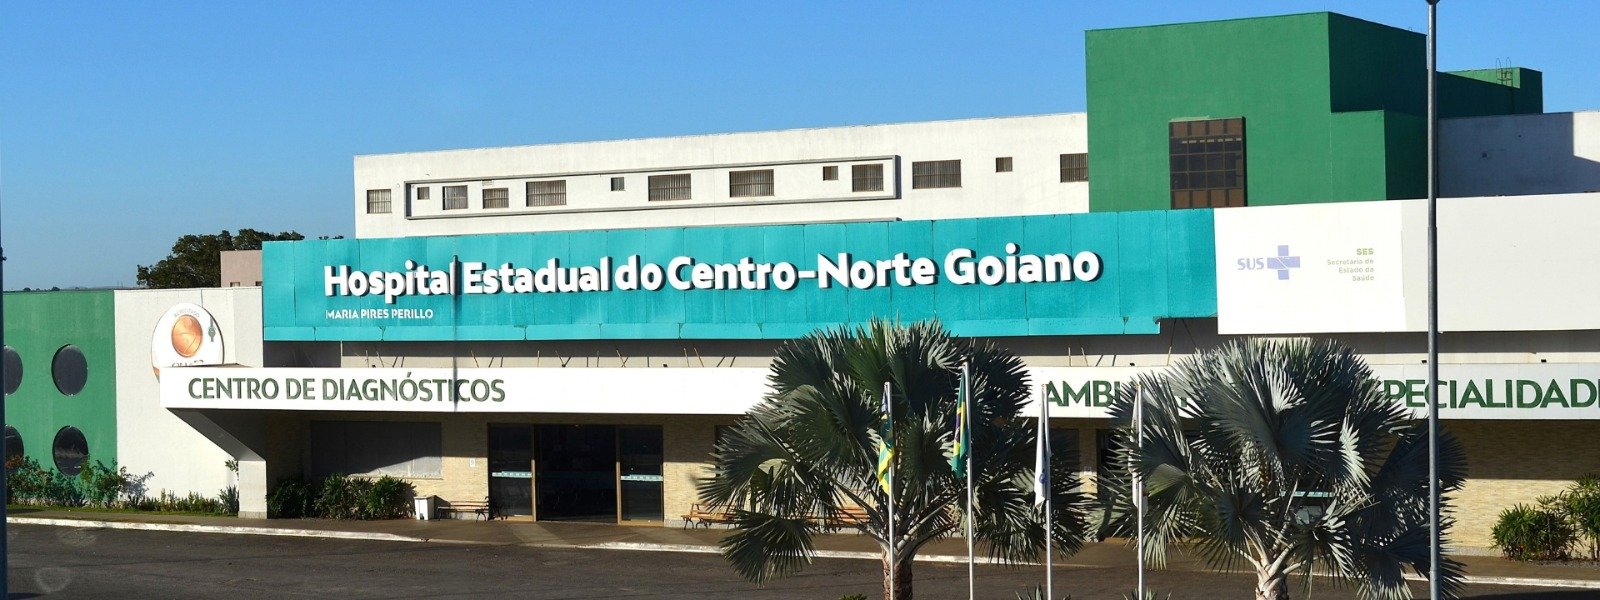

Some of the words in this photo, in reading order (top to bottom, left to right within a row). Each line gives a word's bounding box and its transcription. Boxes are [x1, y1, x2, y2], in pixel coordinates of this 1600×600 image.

[1356, 248, 1375, 256] SES
[1237, 257, 1265, 270] SUS
[1327, 258, 1363, 266] Secretaria
[324, 259, 457, 304] Hospital
[463, 256, 612, 294] Estadual
[614, 254, 665, 292] do
[667, 252, 938, 292] Centro-Norte
[944, 242, 1102, 286] Goiano
[1338, 266, 1363, 274] Estado
[325, 309, 359, 319] MARIA
[360, 308, 389, 319] PIRES
[391, 308, 434, 319] PERILLO
[188, 377, 279, 399] CENTRO
[286, 378, 315, 400] DE
[322, 371, 506, 402] DIAGNÓSTICOS
